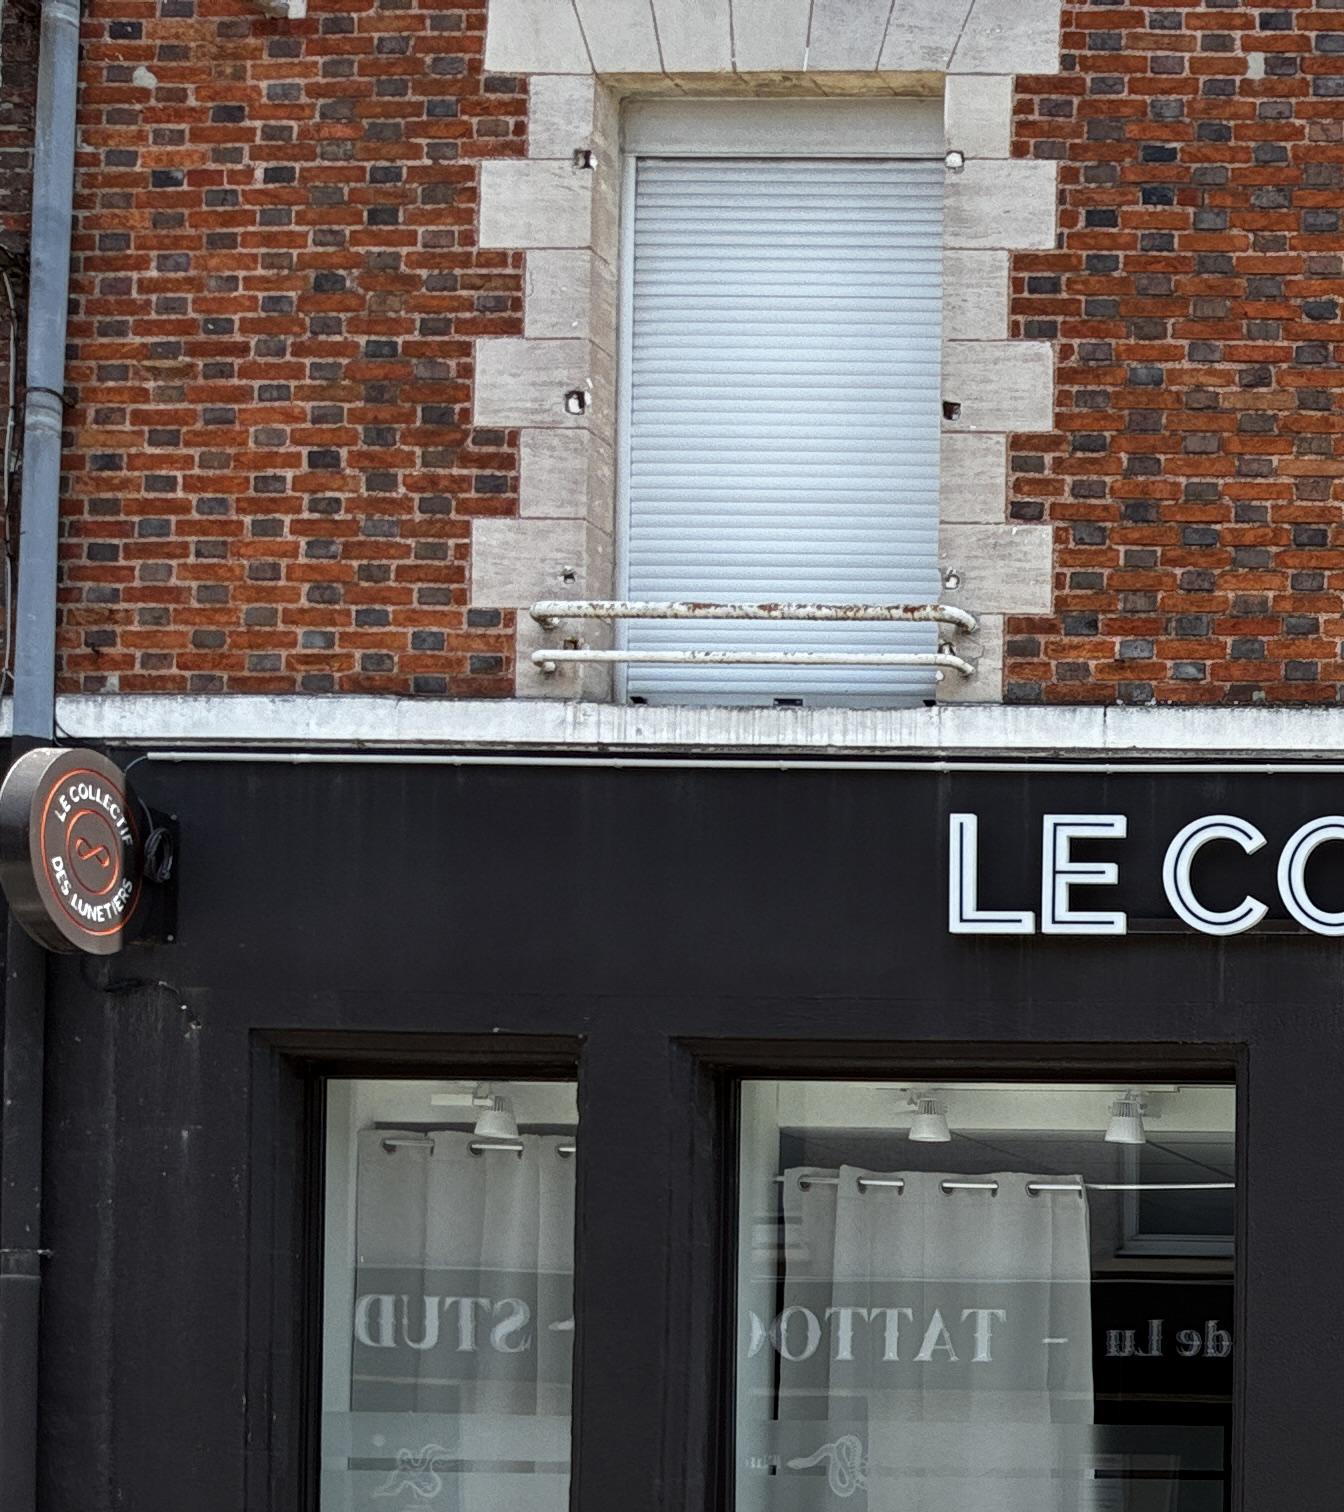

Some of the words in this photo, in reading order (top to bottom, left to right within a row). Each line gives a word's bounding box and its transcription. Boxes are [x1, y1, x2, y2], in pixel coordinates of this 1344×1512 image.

[54, 794, 72, 823] LE
[69, 783, 133, 846] COLLECTIF
[51, 856, 72, 896] DES
[70, 877, 133, 922] LUNETIERS
[946, 812, 1128, 936] LE
